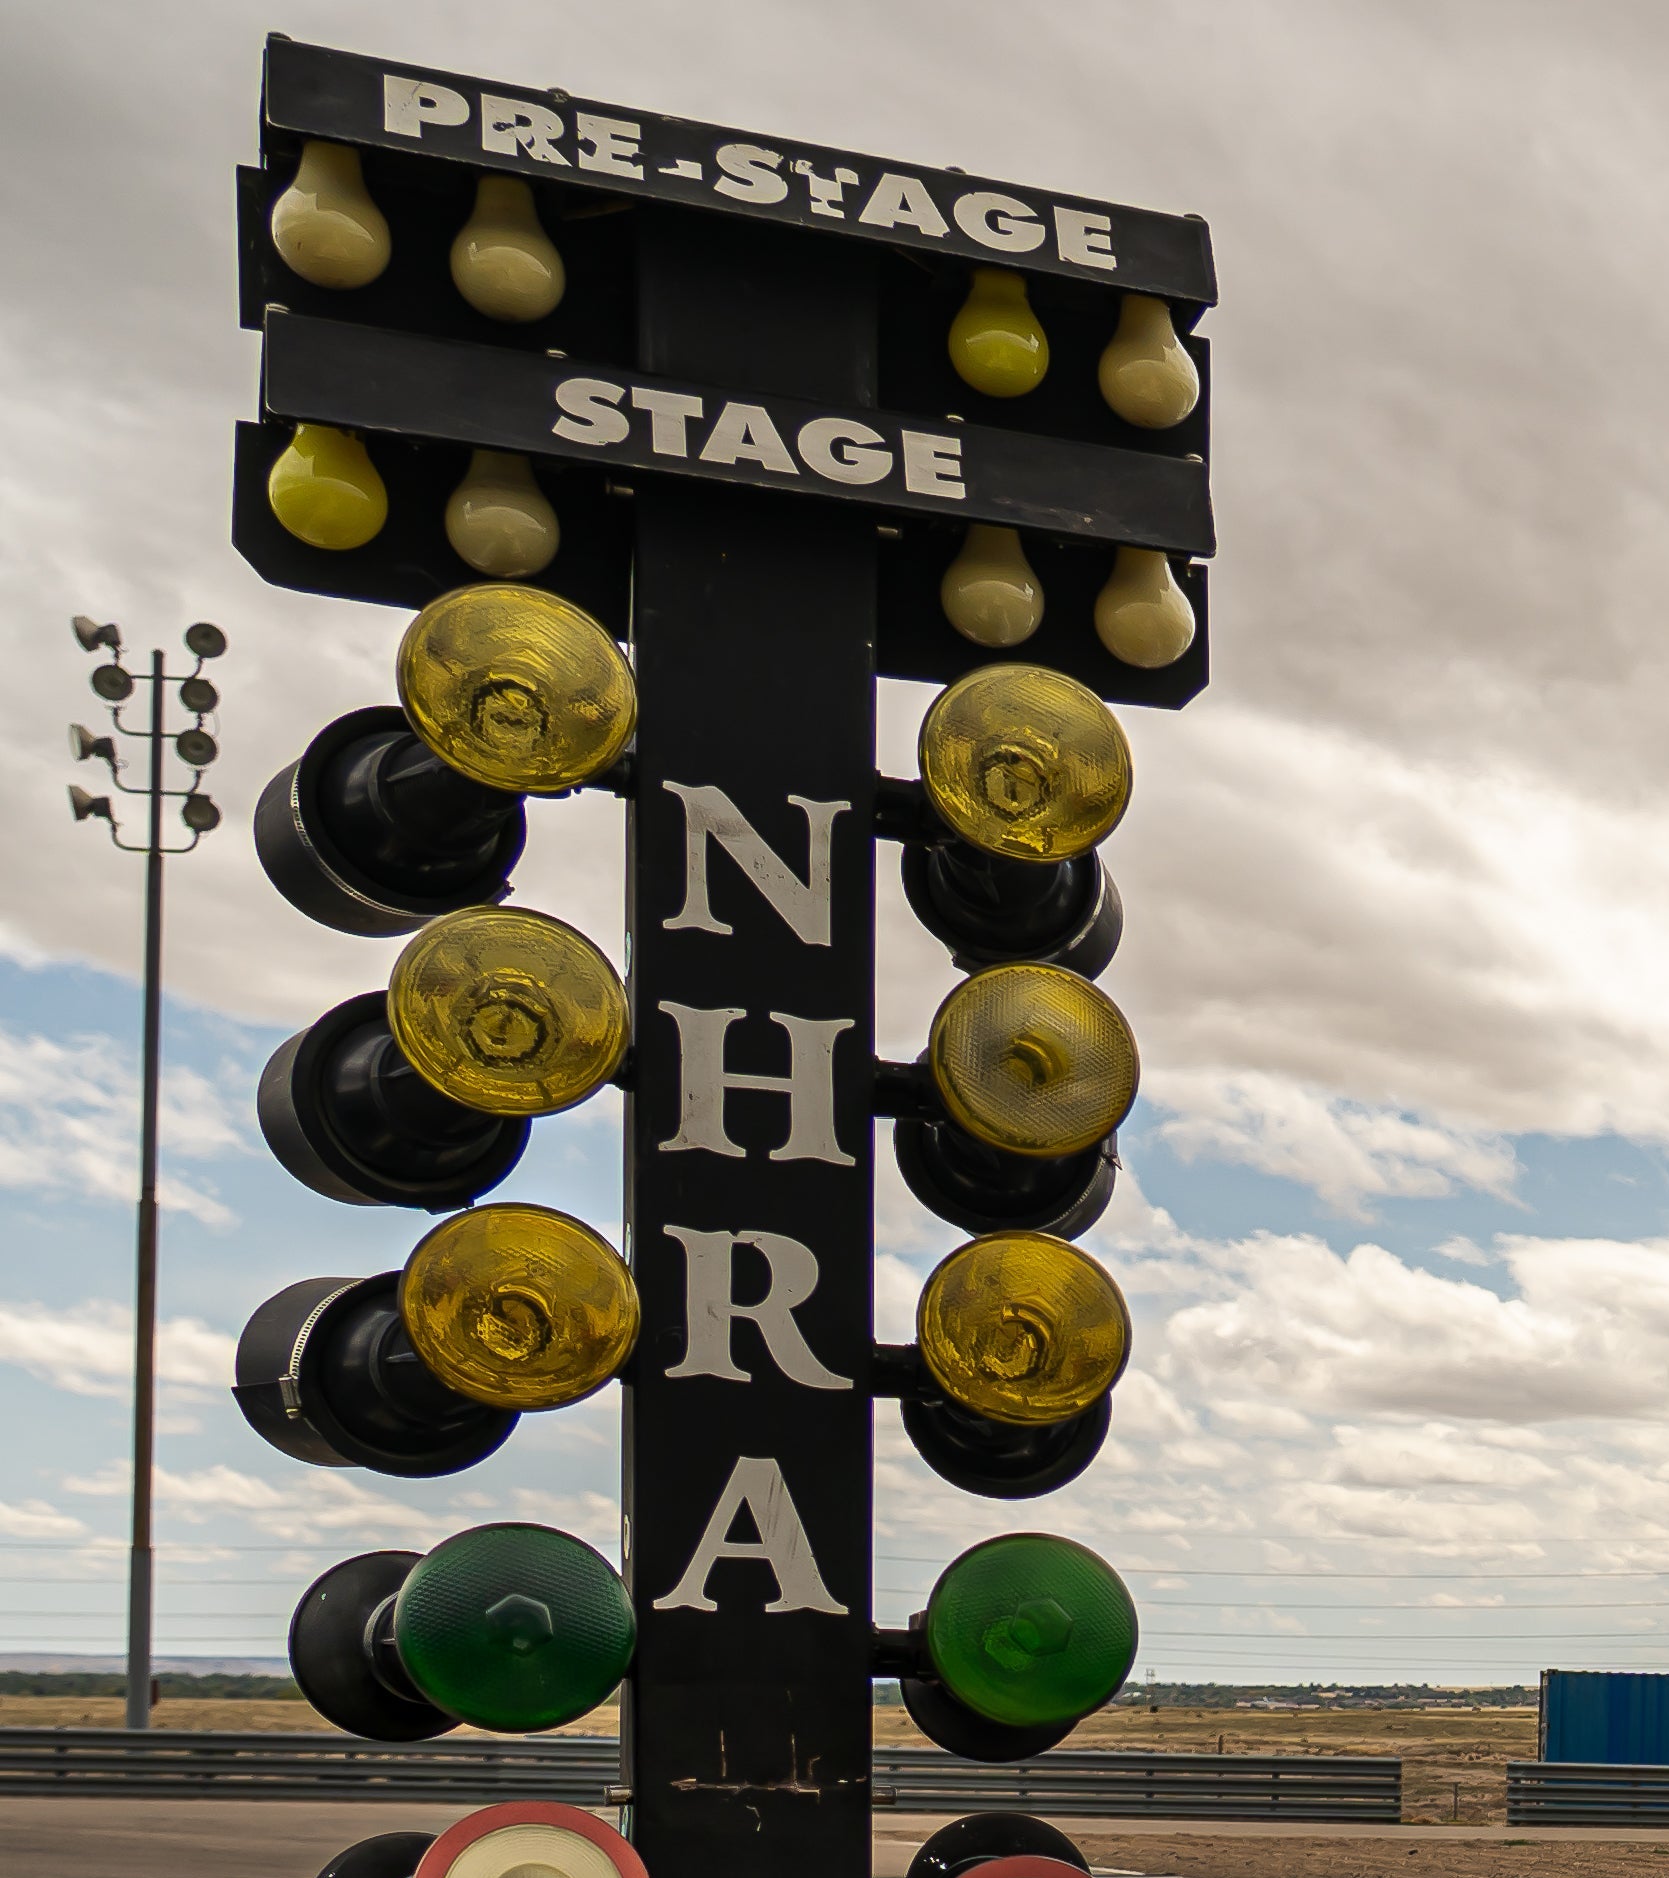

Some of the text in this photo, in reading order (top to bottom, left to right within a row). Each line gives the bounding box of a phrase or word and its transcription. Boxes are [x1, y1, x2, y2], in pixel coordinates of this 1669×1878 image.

[381, 73, 1118, 272] PRE-STAGE
[552, 377, 966, 500] STAGE
[653, 780, 856, 1615] NHRA
